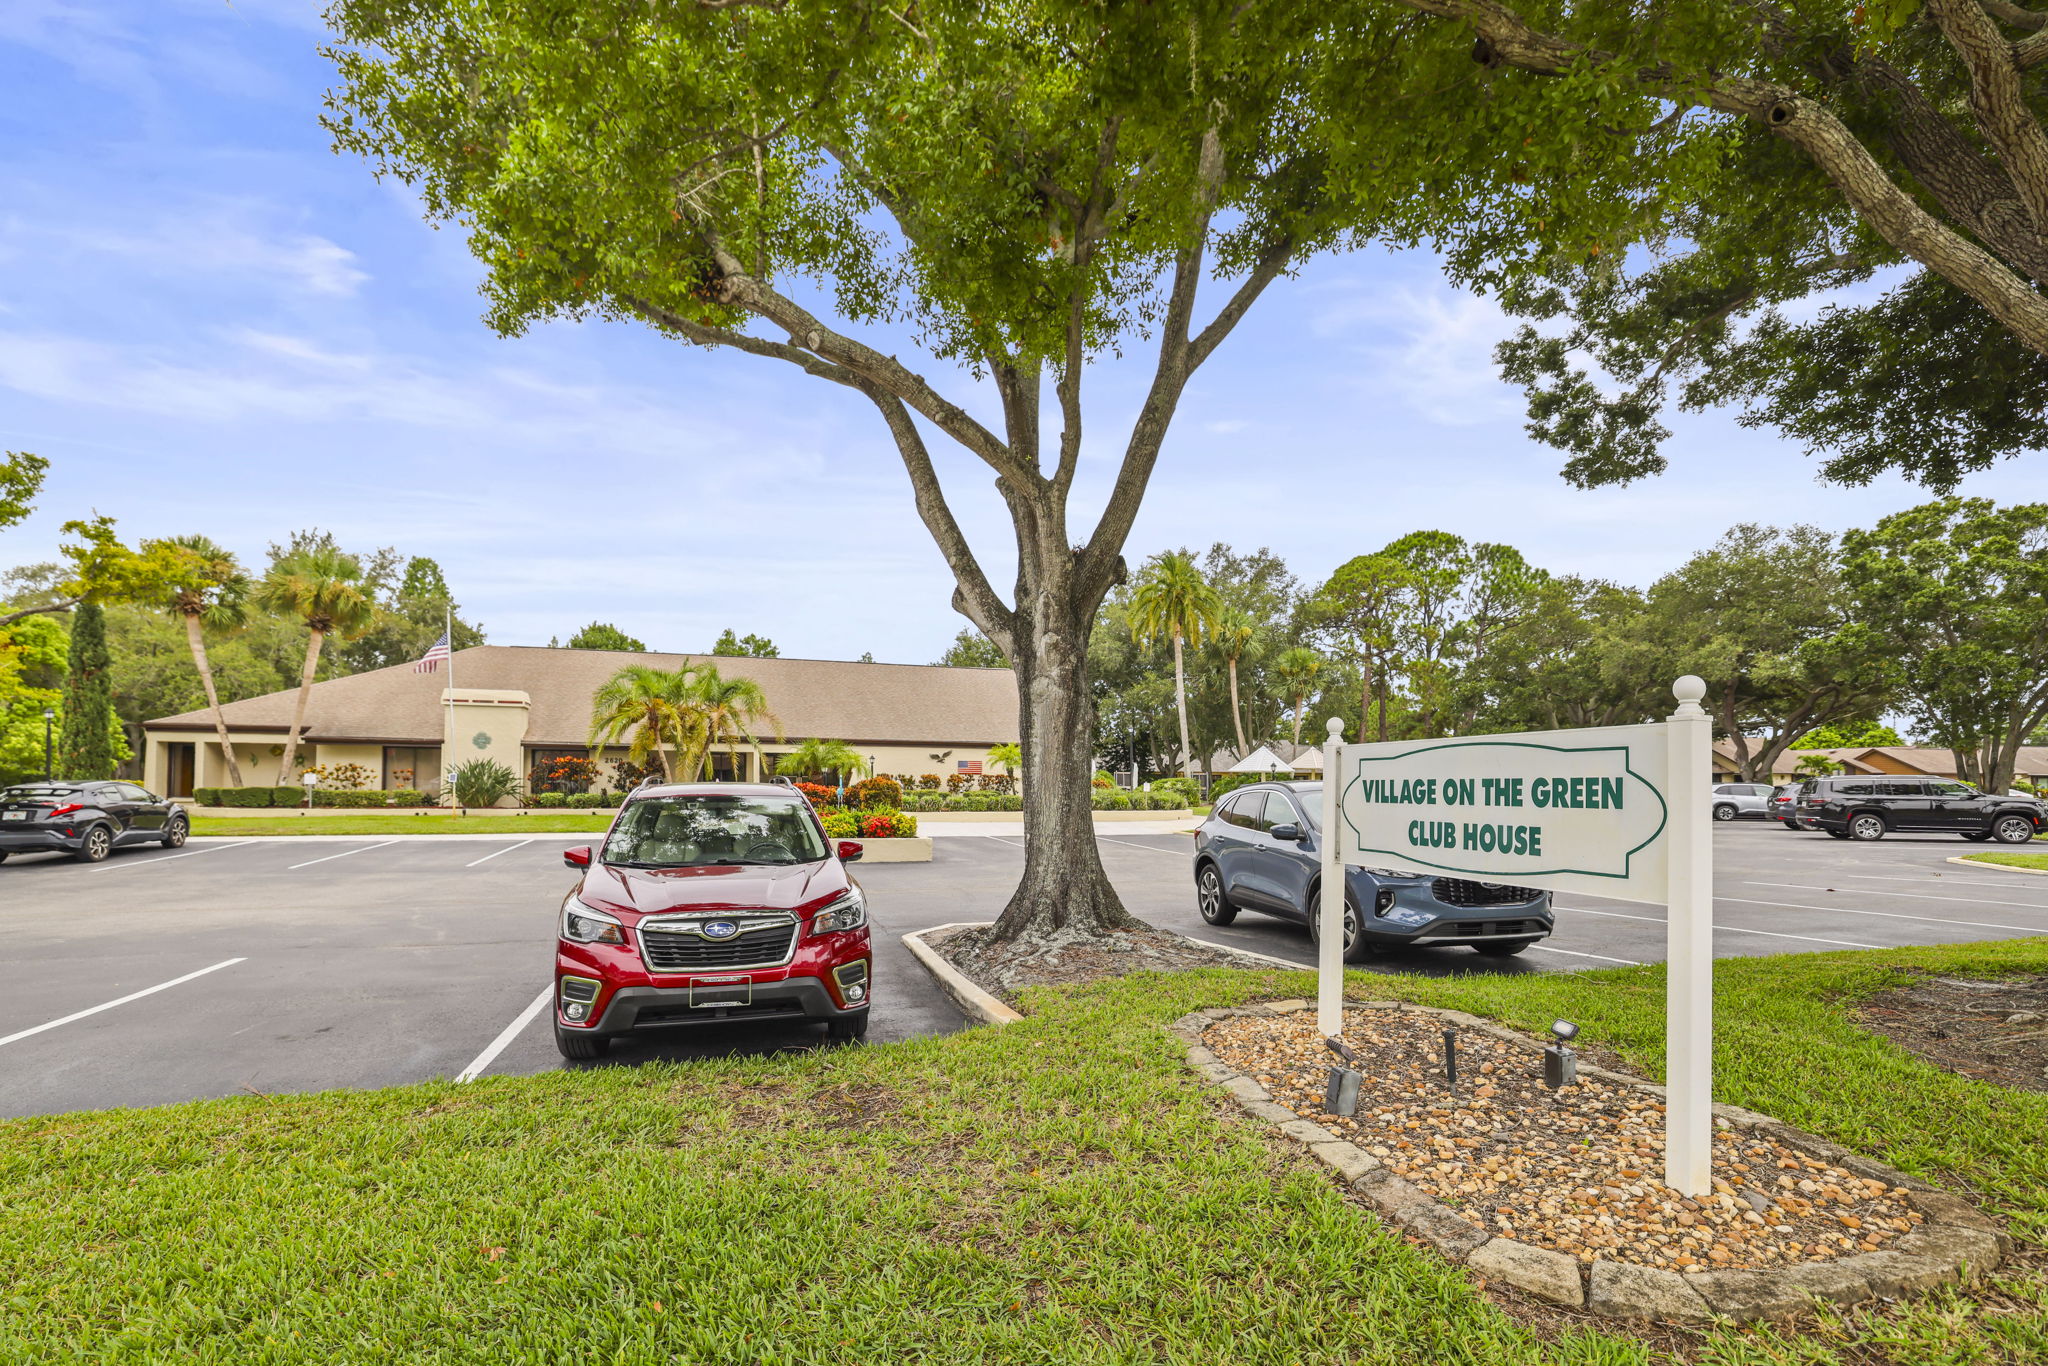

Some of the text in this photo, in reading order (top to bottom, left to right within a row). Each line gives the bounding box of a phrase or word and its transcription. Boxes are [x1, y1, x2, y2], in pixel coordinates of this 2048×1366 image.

[1362, 777, 1624, 809] VILLAGE ON THE GREEN
[1408, 820, 1542, 857] CLUB HOUSE
